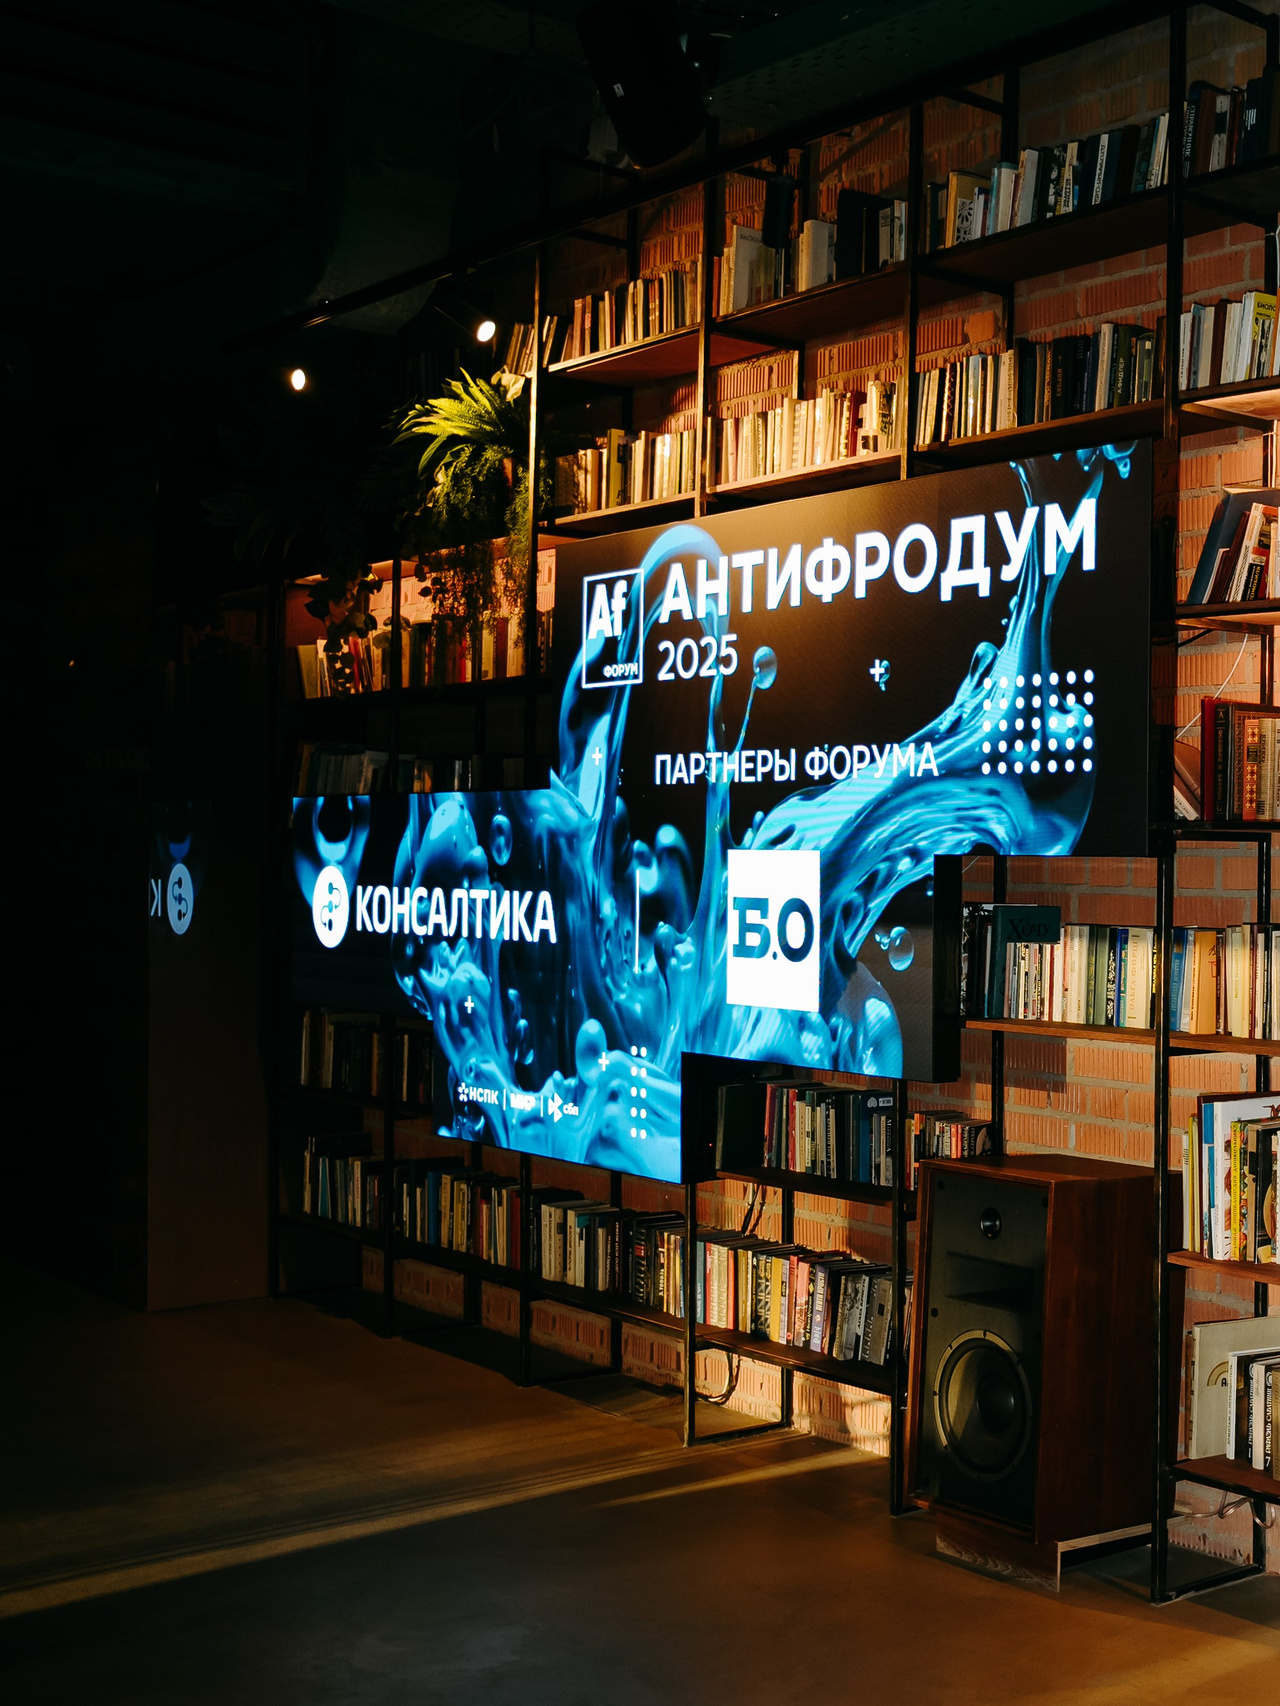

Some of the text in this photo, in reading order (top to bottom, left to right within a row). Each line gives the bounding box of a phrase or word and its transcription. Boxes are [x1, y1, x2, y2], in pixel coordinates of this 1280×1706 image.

[658, 498, 1097, 624] АНТИФРОДУМ
[587, 579, 628, 640] Af
[603, 661, 639, 679] ФОРУМ
[657, 634, 739, 682] 2025
[655, 741, 939, 785] ПАРТНЕРЫ ФОРУМА
[355, 884, 558, 944] КОНСАЛТИКА
[732, 896, 815, 963] Б.О
[1007, 917, 1052, 940] Хочу
[469, 1086, 499, 1105] НСПК
[510, 1093, 536, 1111] МИР
[563, 1103, 579, 1117] сбп
[1265, 1388, 1273, 1422] САБАТИНИ
